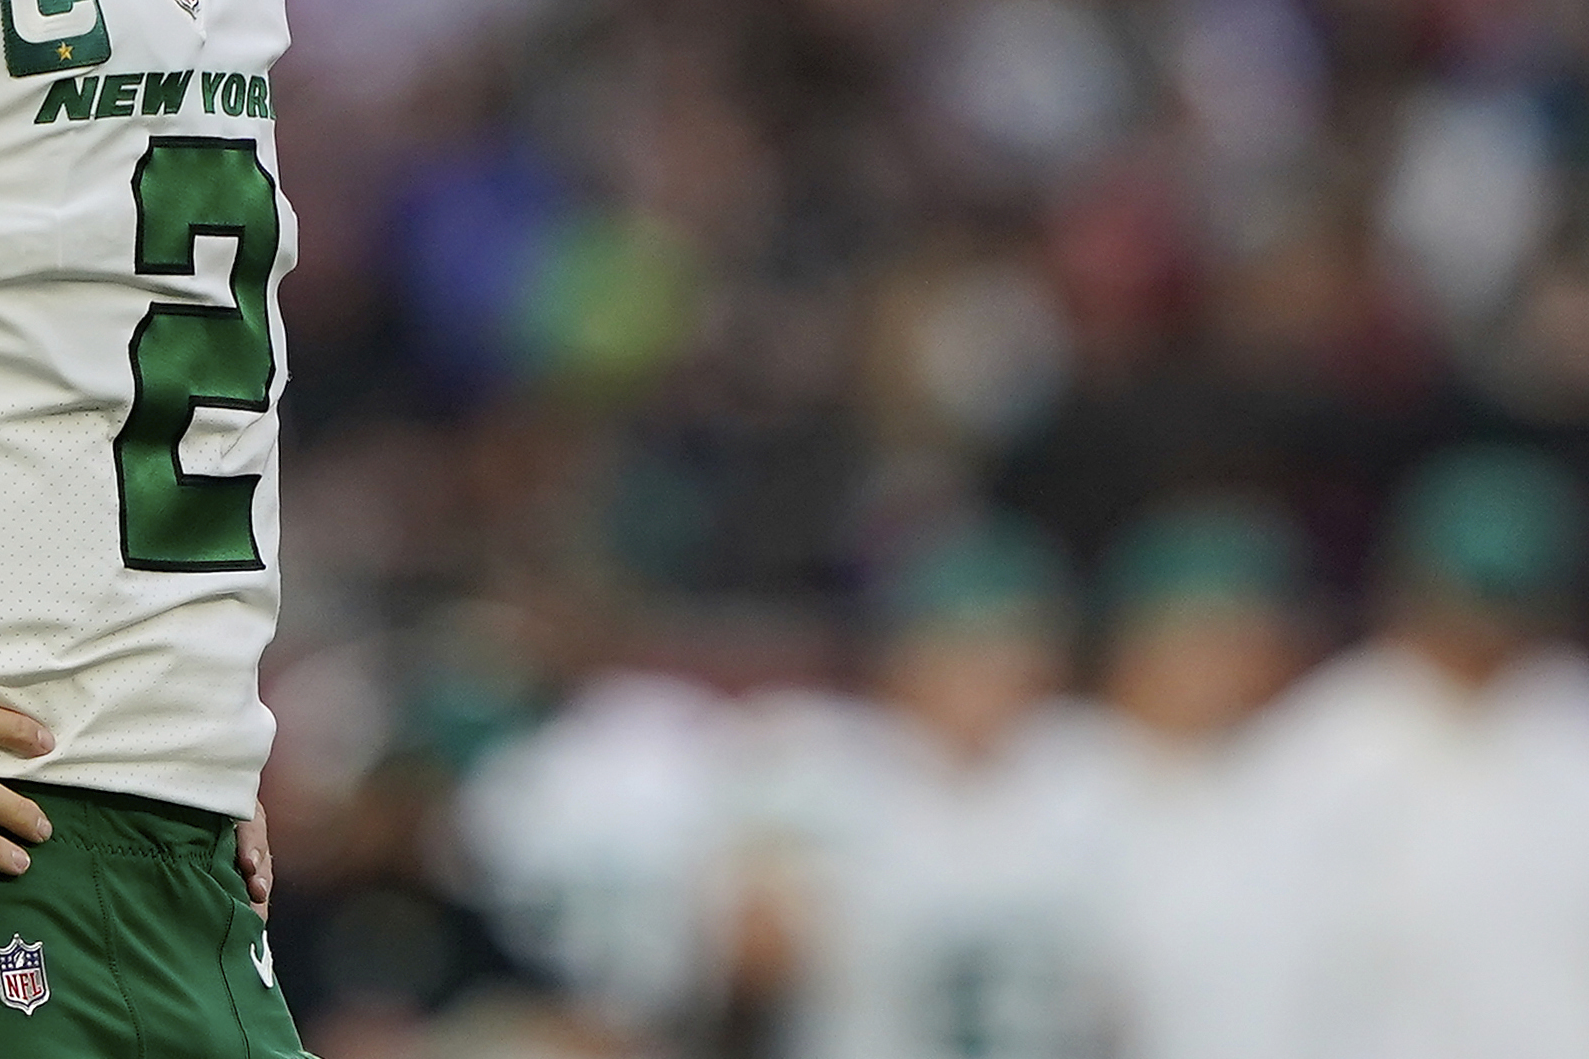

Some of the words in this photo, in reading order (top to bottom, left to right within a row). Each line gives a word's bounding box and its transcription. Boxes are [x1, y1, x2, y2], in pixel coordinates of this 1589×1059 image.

[34, 70, 194, 124] NEW
[113, 136, 279, 571] 2
[5, 972, 42, 1000] NFL
